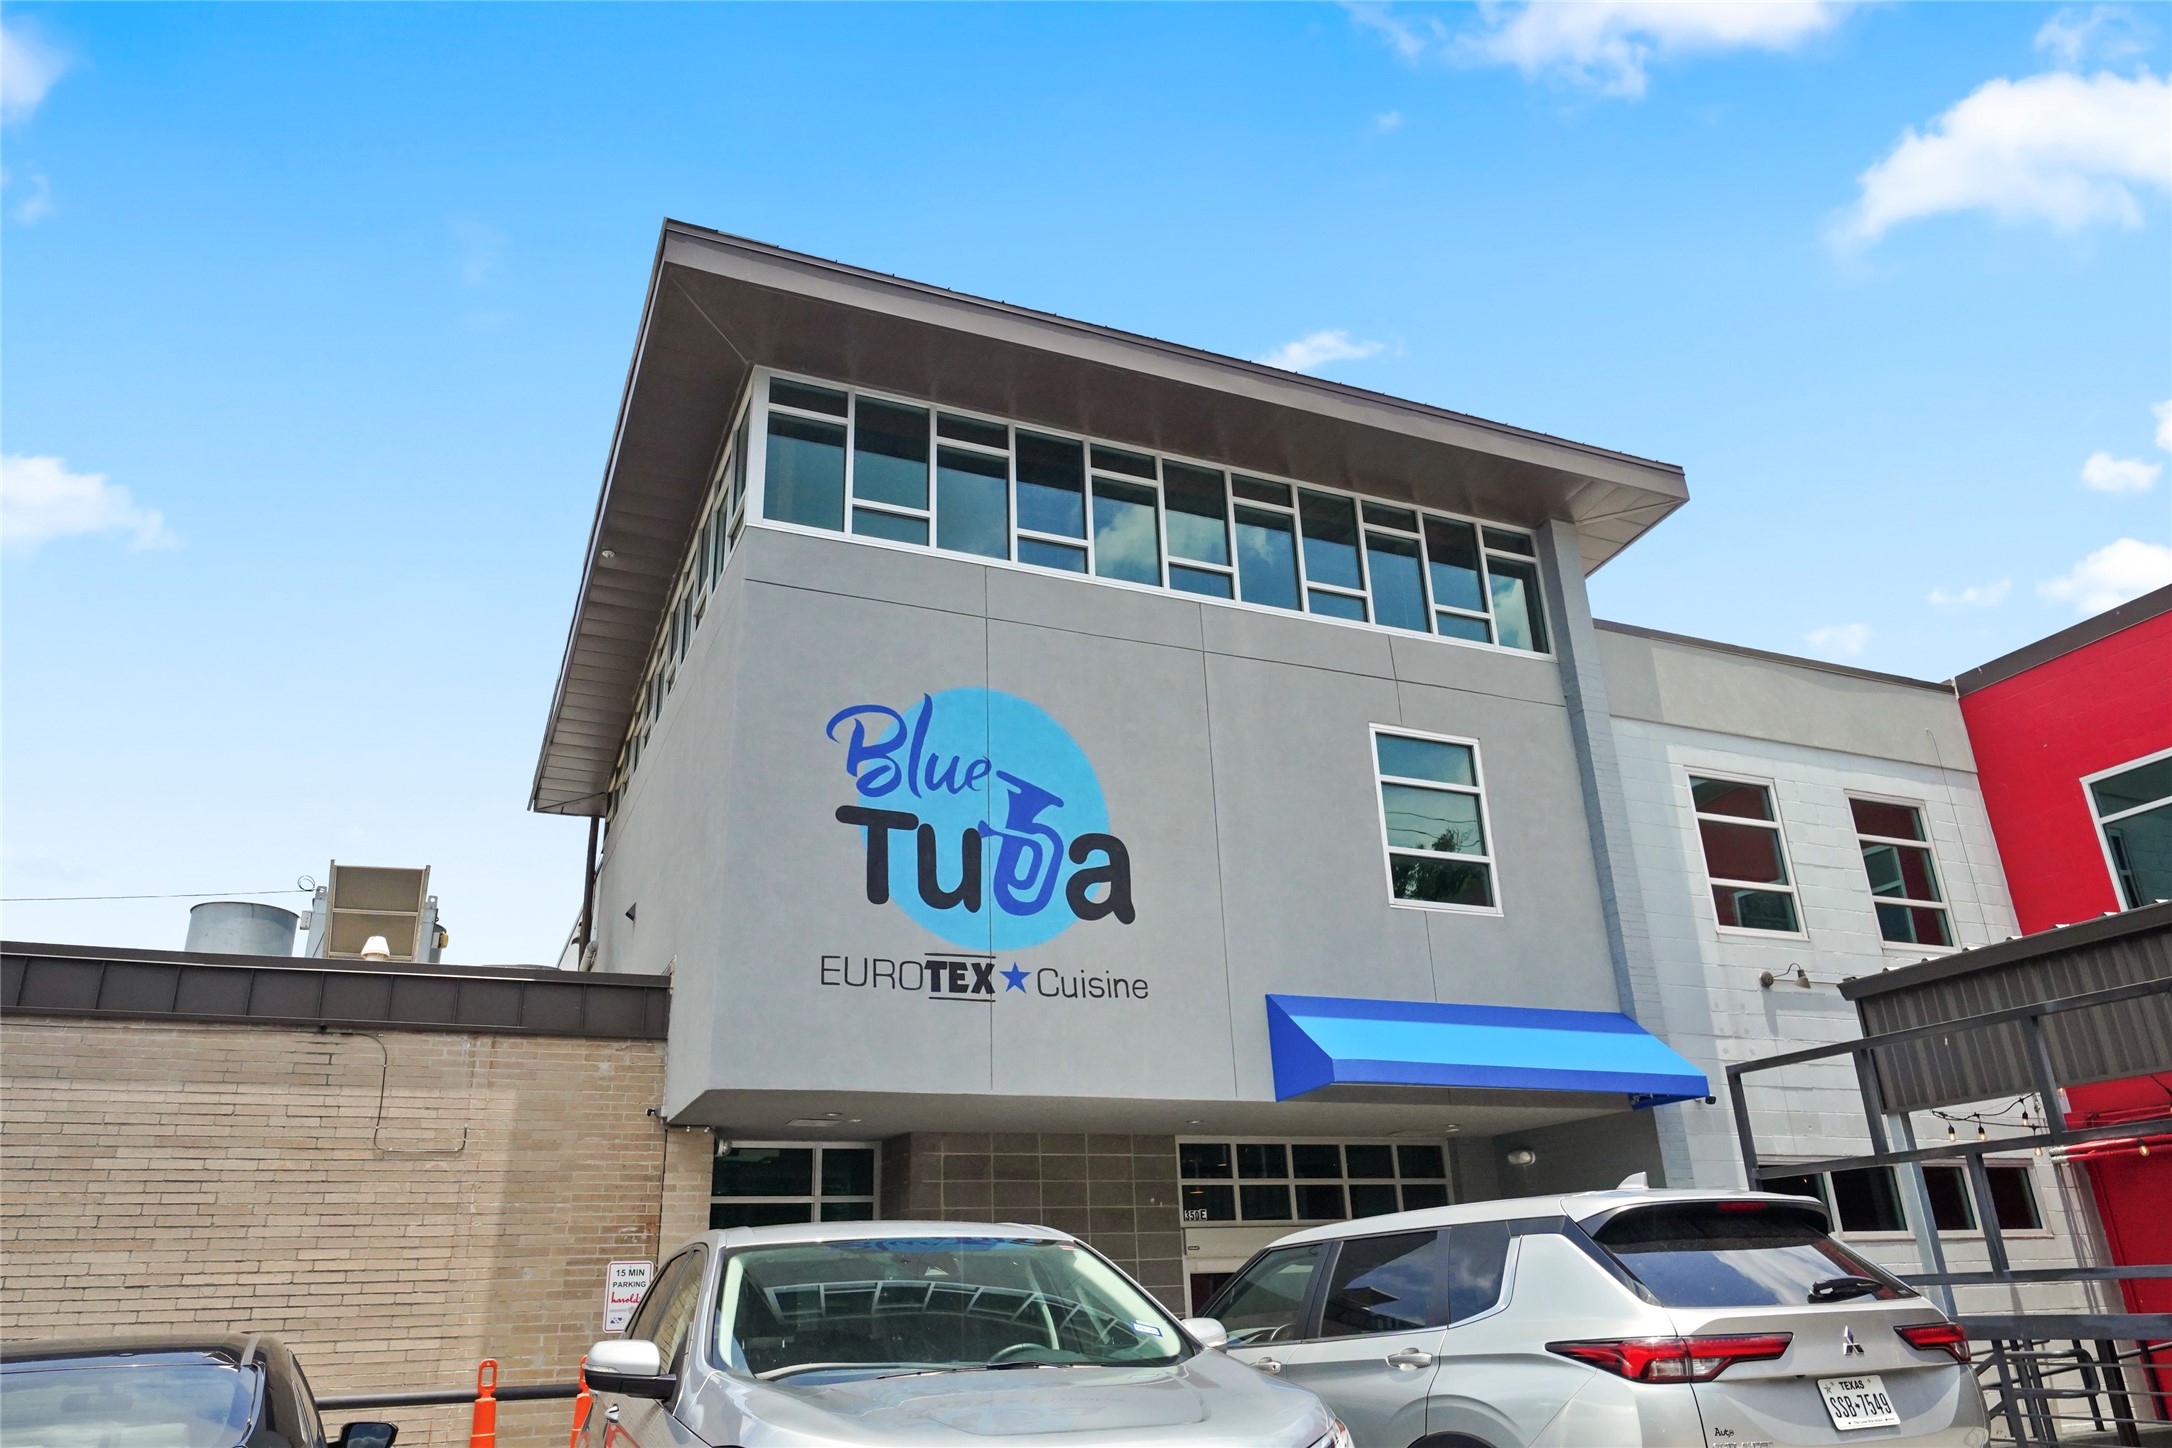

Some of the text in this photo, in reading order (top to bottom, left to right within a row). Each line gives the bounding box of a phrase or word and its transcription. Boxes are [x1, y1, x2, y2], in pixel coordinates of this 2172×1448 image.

[826, 692, 992, 799] Blue
[1036, 967, 1149, 999] Cuisine
[616, 1269, 645, 1277] 15 MIN
[1839, 1380, 1865, 1391] TEXAS
